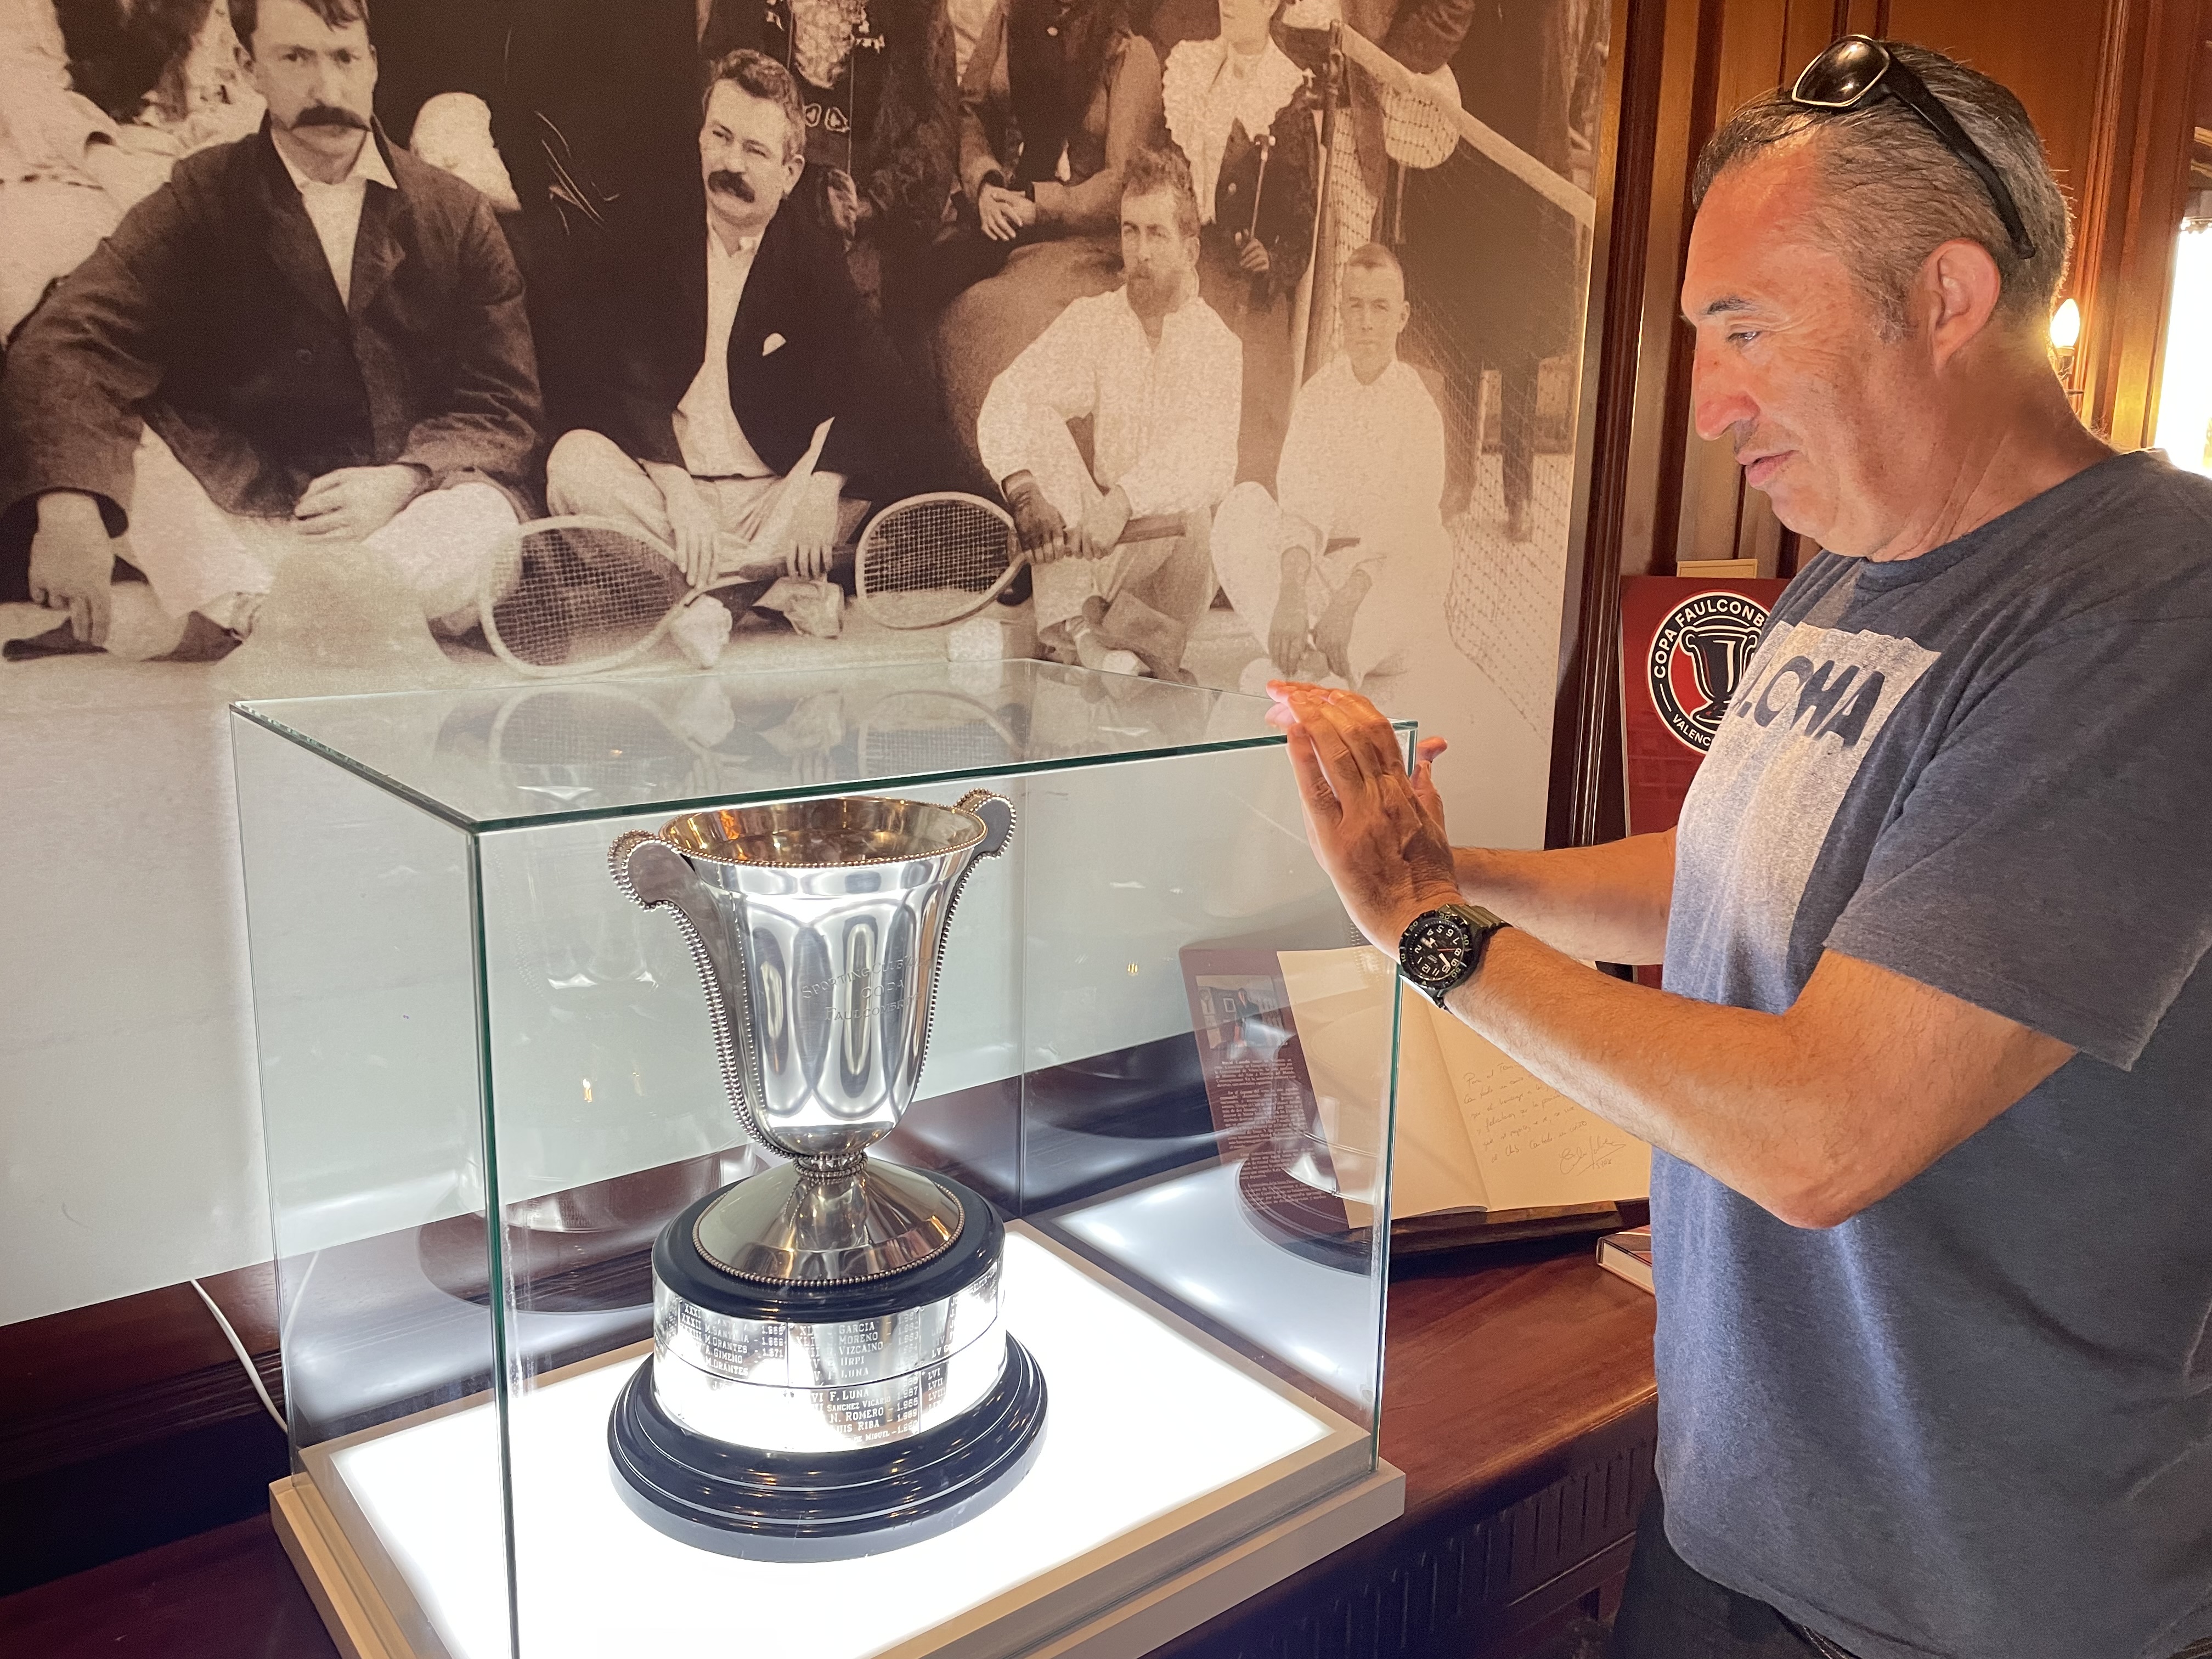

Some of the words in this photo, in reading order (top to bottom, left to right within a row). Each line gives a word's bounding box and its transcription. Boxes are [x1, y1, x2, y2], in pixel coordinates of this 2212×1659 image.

[1654, 629, 1678, 678] COPA
[1675, 599, 1764, 628] FAULCONB
[1672, 714, 1711, 747] VALENC
[839, 1322, 875, 1334] GARCIA
[839, 1332, 878, 1345] MORENO
[839, 1341, 883, 1355] VIZCAINO
[843, 1388, 869, 1400] LUNA
[845, 1407, 884, 1422] ROMERO
[857, 1419, 879, 1431] RIBA
